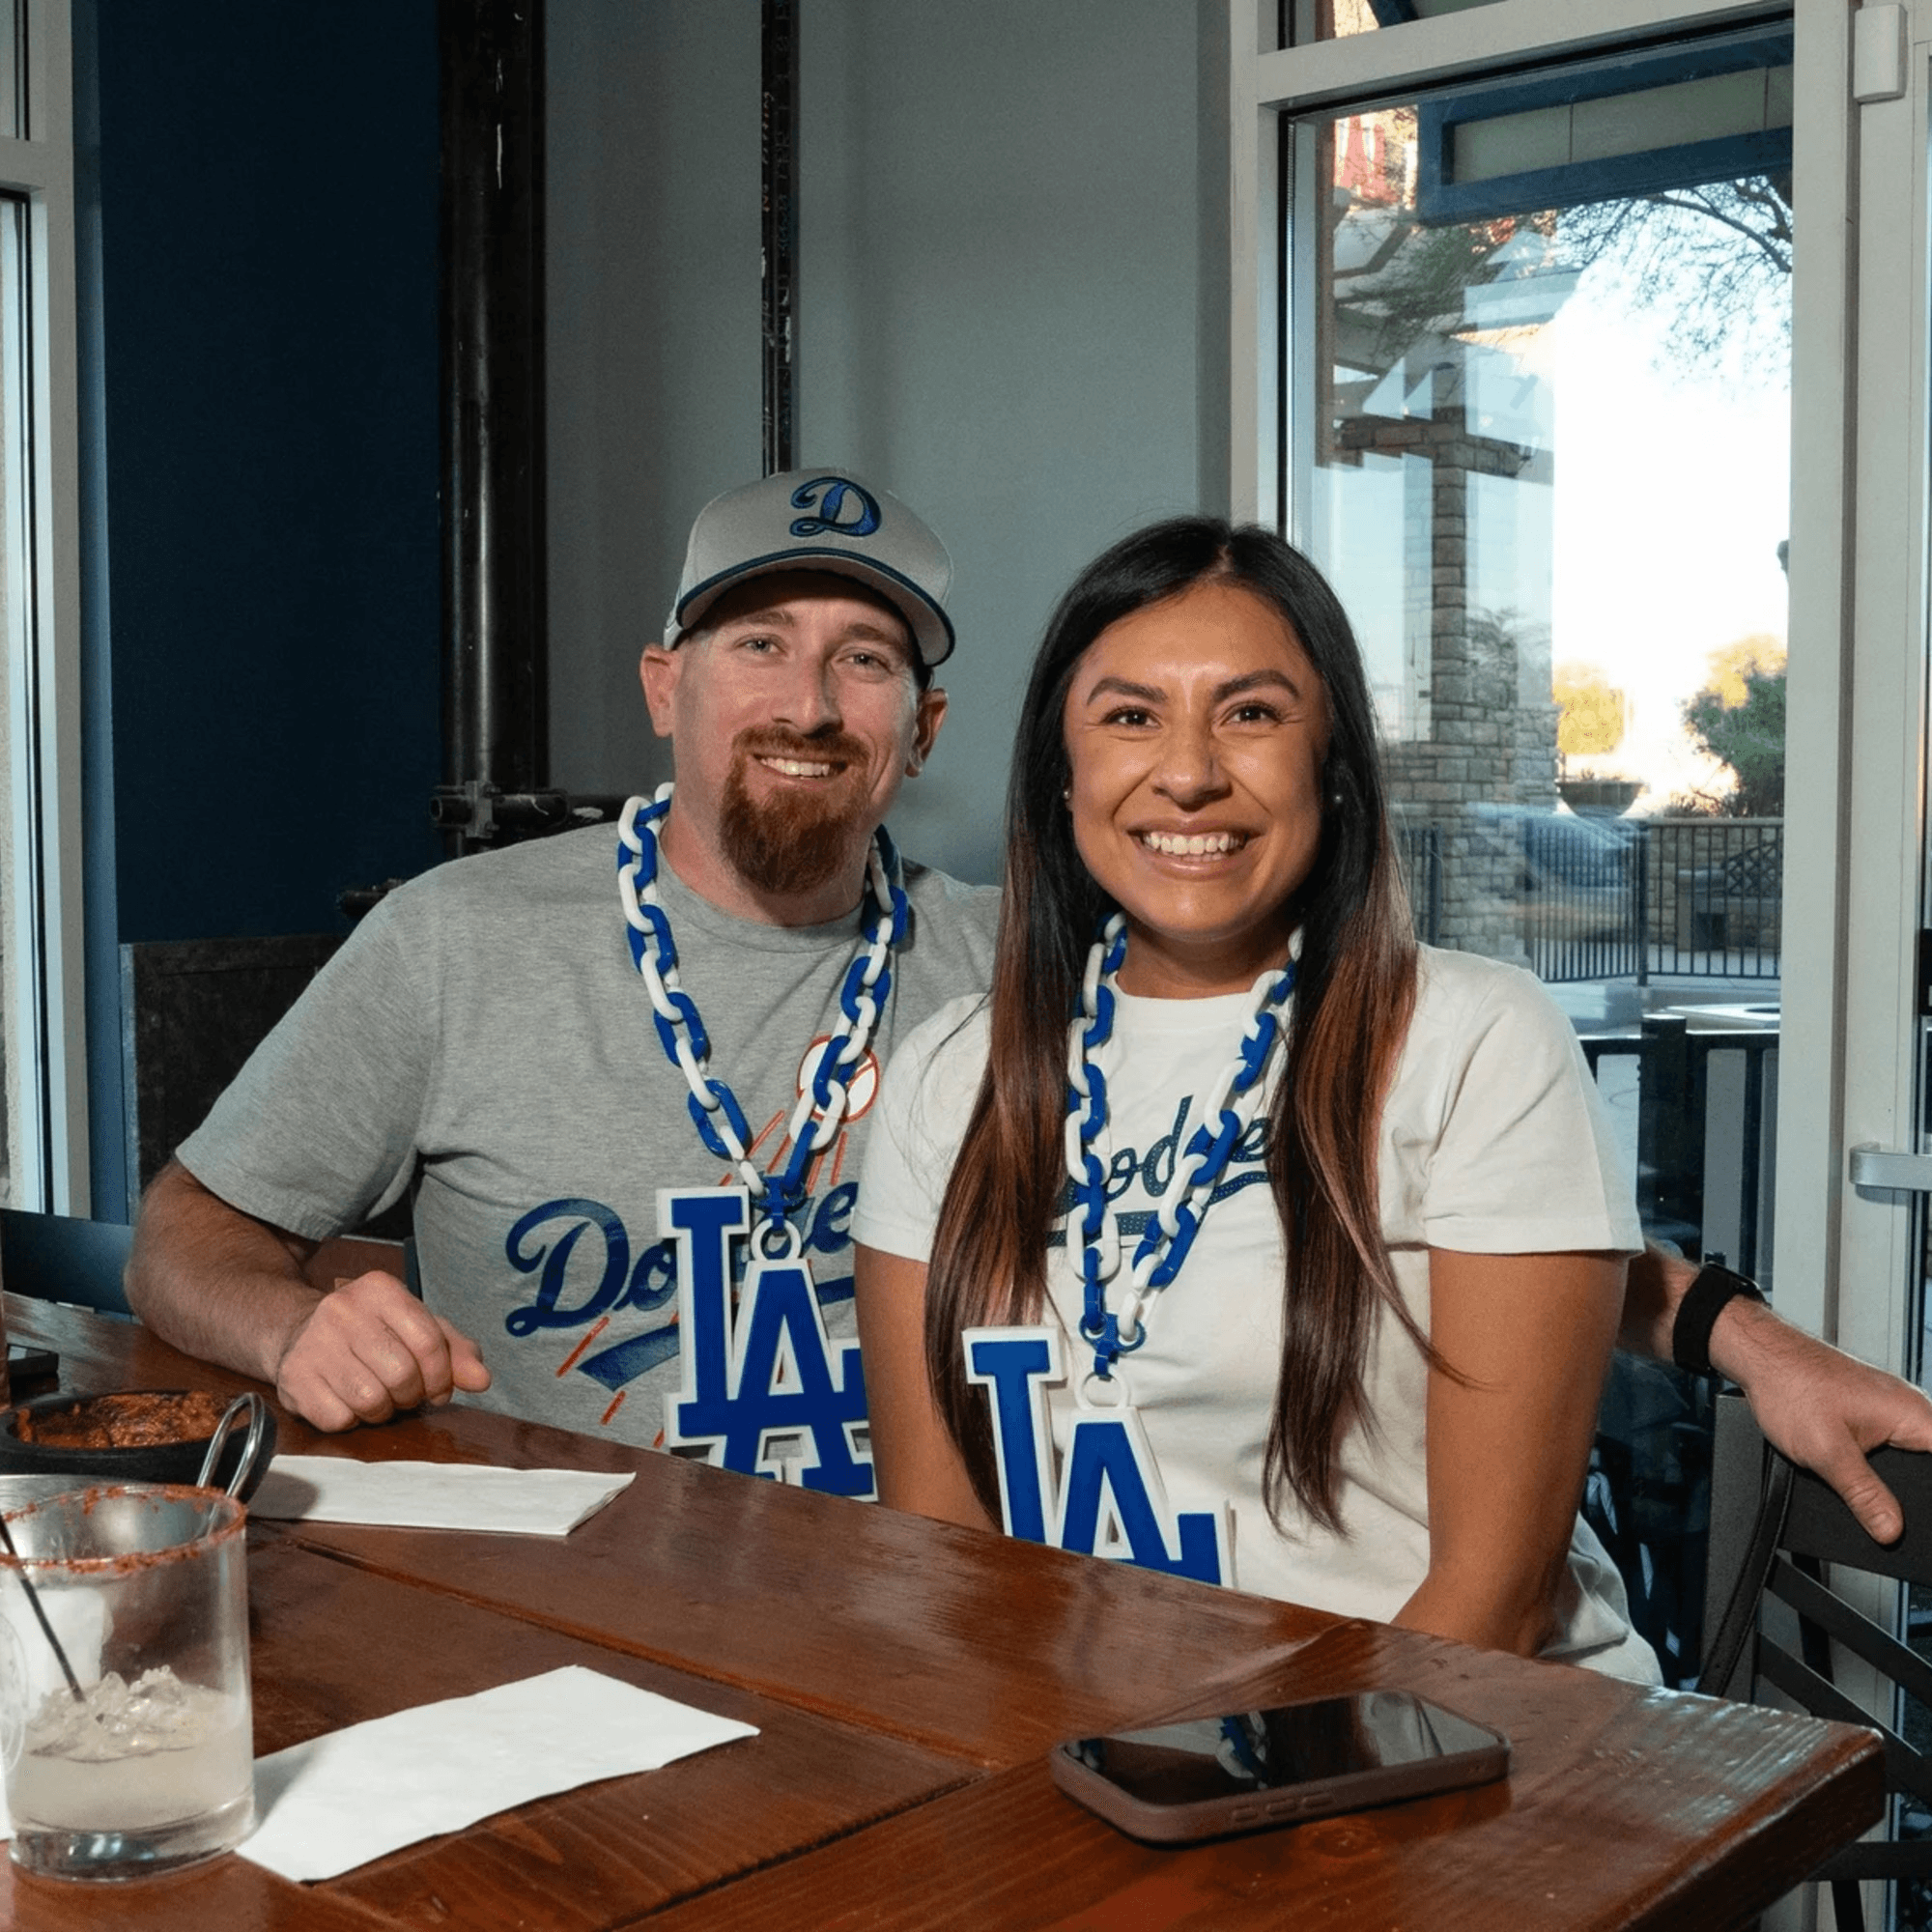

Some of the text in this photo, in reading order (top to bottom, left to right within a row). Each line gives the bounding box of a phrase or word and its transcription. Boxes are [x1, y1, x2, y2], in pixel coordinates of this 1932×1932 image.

[789, 476, 882, 537] D
[663, 1190, 877, 1498] LA
[968, 1335, 1227, 1586] LA
